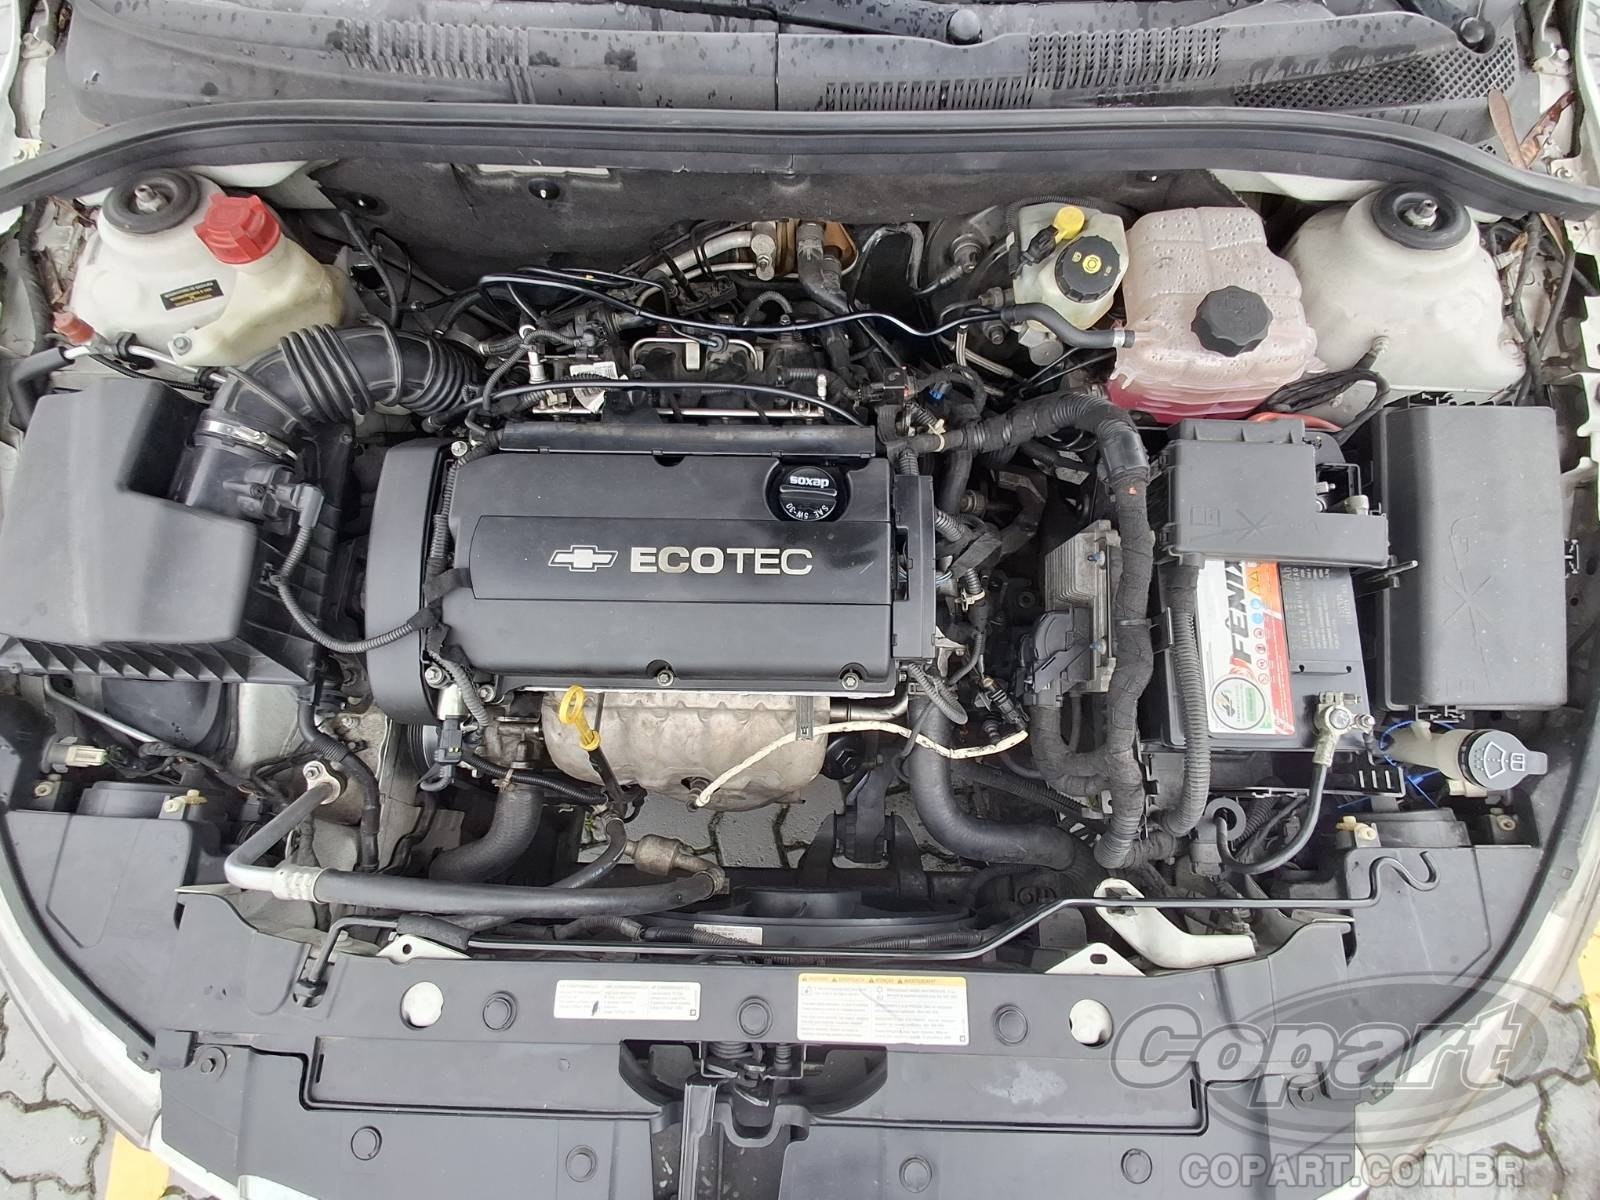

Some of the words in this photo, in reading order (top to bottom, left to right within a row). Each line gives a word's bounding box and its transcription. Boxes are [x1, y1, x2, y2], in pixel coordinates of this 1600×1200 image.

[789, 475, 829, 489] dexos
[785, 503, 809, 519] 5W-30
[813, 504, 829, 519] SAE
[630, 546, 813, 576] ECOTEC
